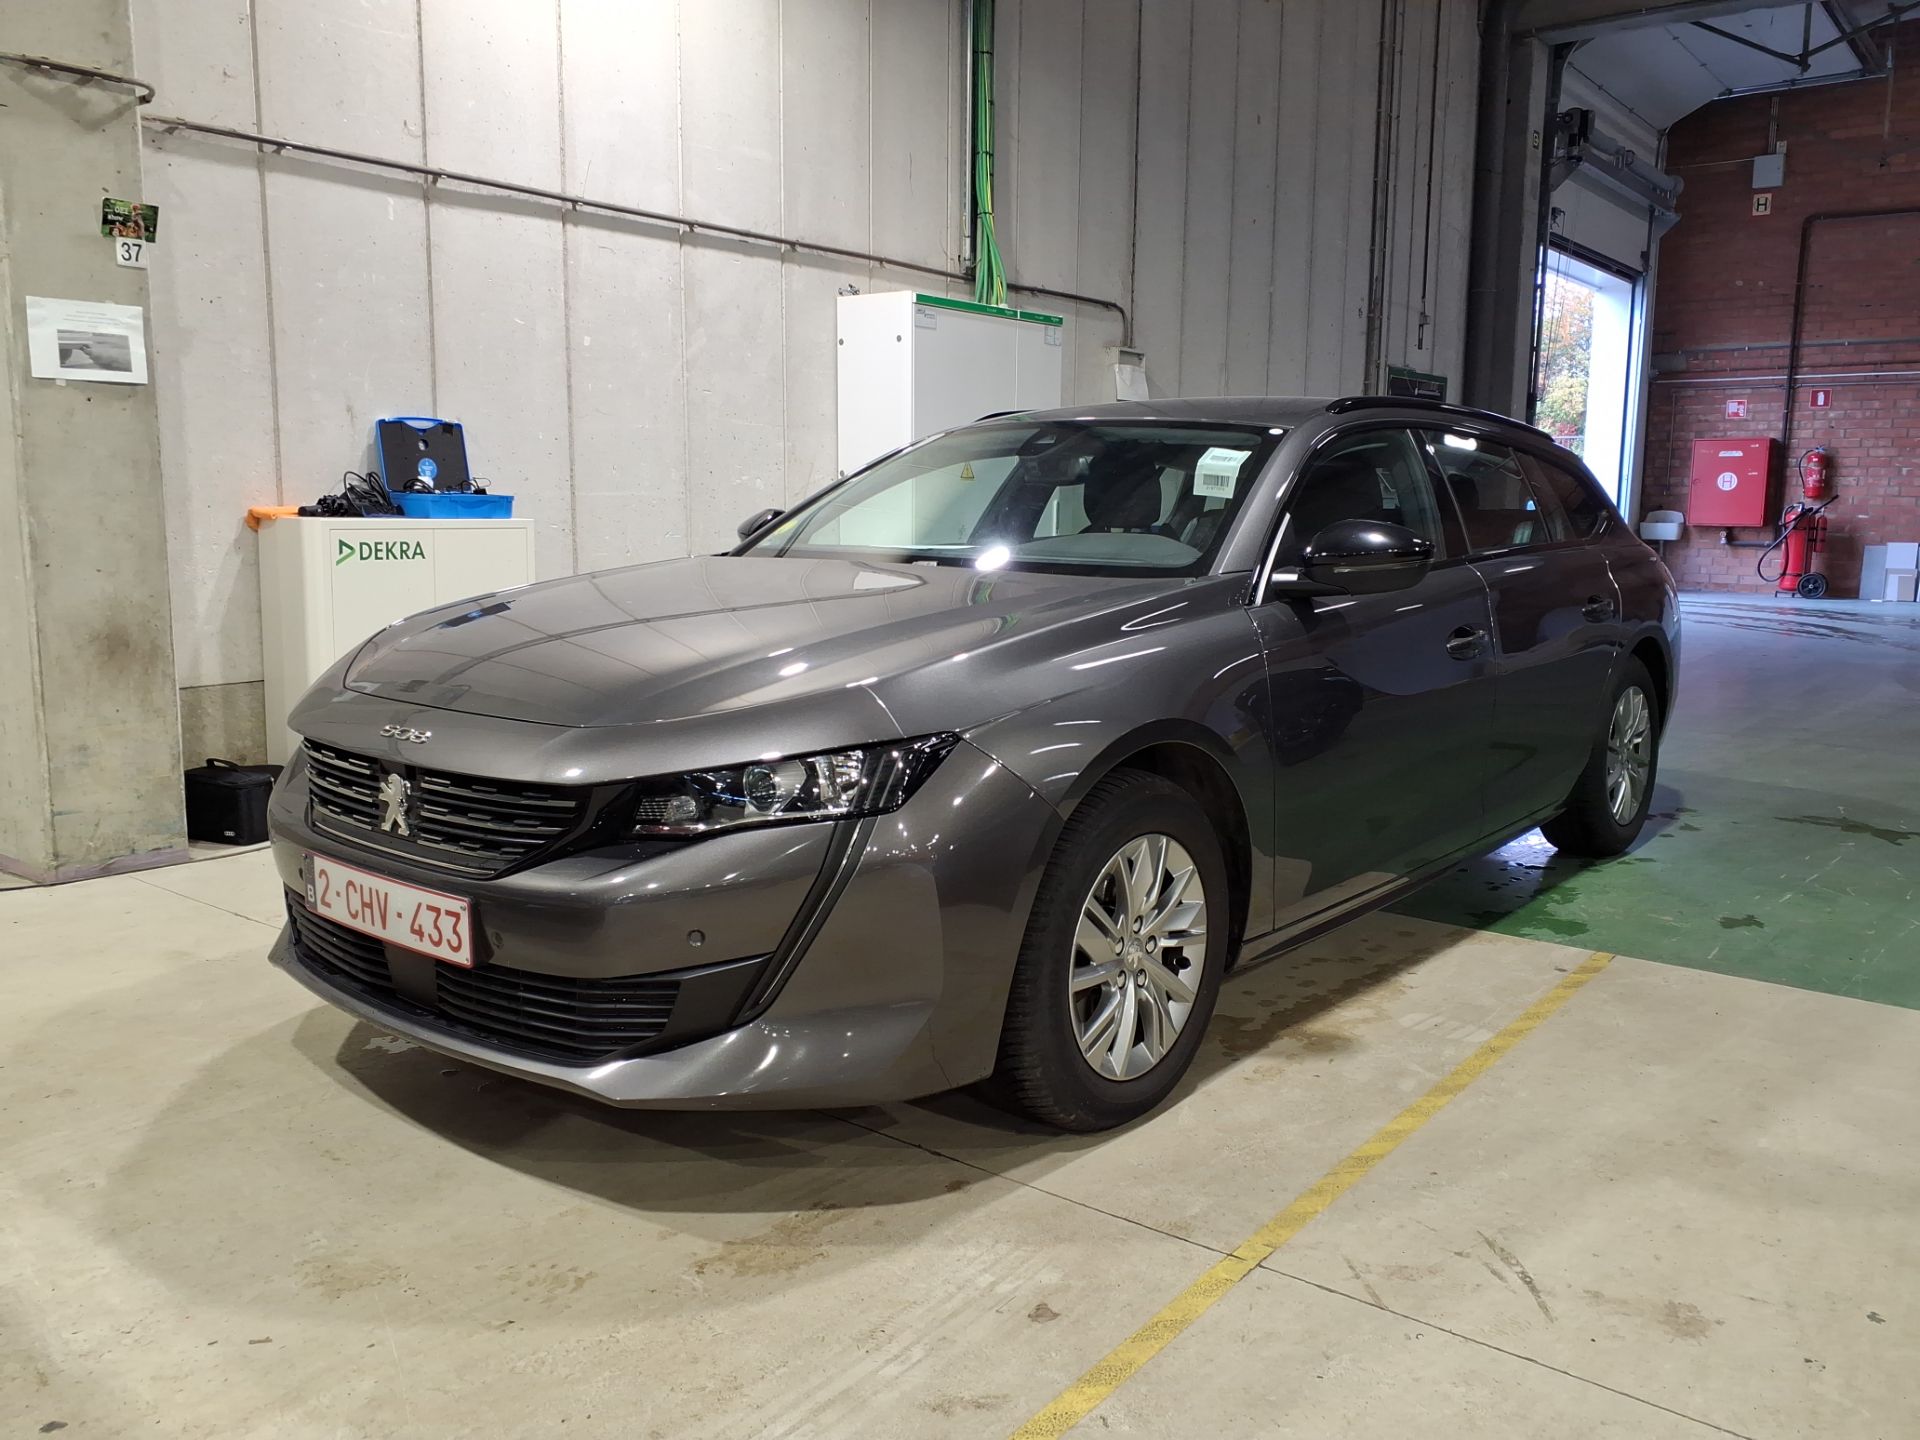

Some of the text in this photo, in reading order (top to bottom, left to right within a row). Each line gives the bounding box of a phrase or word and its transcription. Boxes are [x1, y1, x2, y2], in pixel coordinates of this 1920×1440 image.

[1756, 197, 1768, 212] H
[121, 242, 142, 262] 37
[1722, 474, 1733, 489] H
[359, 541, 426, 561] DEKRA
[380, 725, 432, 744] 508
[319, 868, 463, 953] 2-CHV-433
